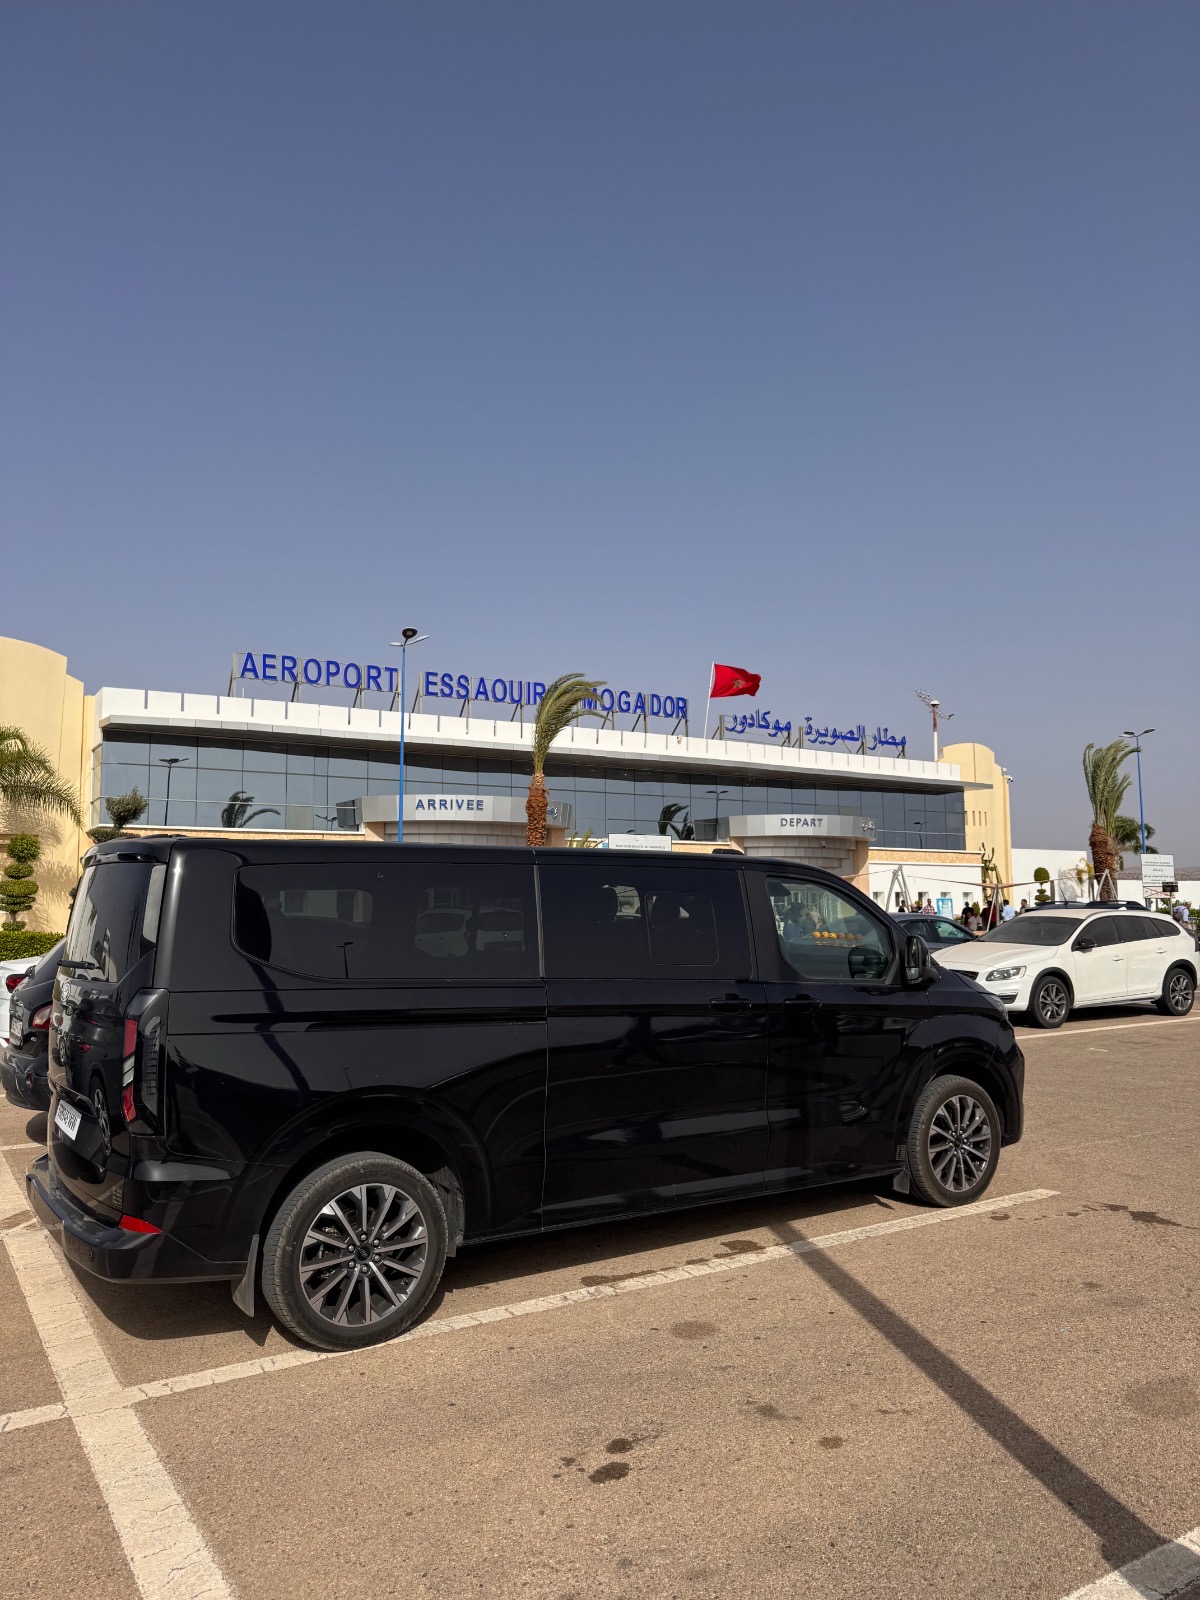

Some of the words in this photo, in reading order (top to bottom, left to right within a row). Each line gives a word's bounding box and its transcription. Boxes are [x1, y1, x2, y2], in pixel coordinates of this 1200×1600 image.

[240, 651, 399, 692] AEROPORT
[424, 671, 547, 706] ESSAOUIR
[725, 709, 792, 738] موكادور
[804, 716, 866, 746] الصويرة
[867, 727, 907, 750] مطار
[415, 799, 484, 811] ARRIVEE
[780, 817, 823, 827] DEPART
